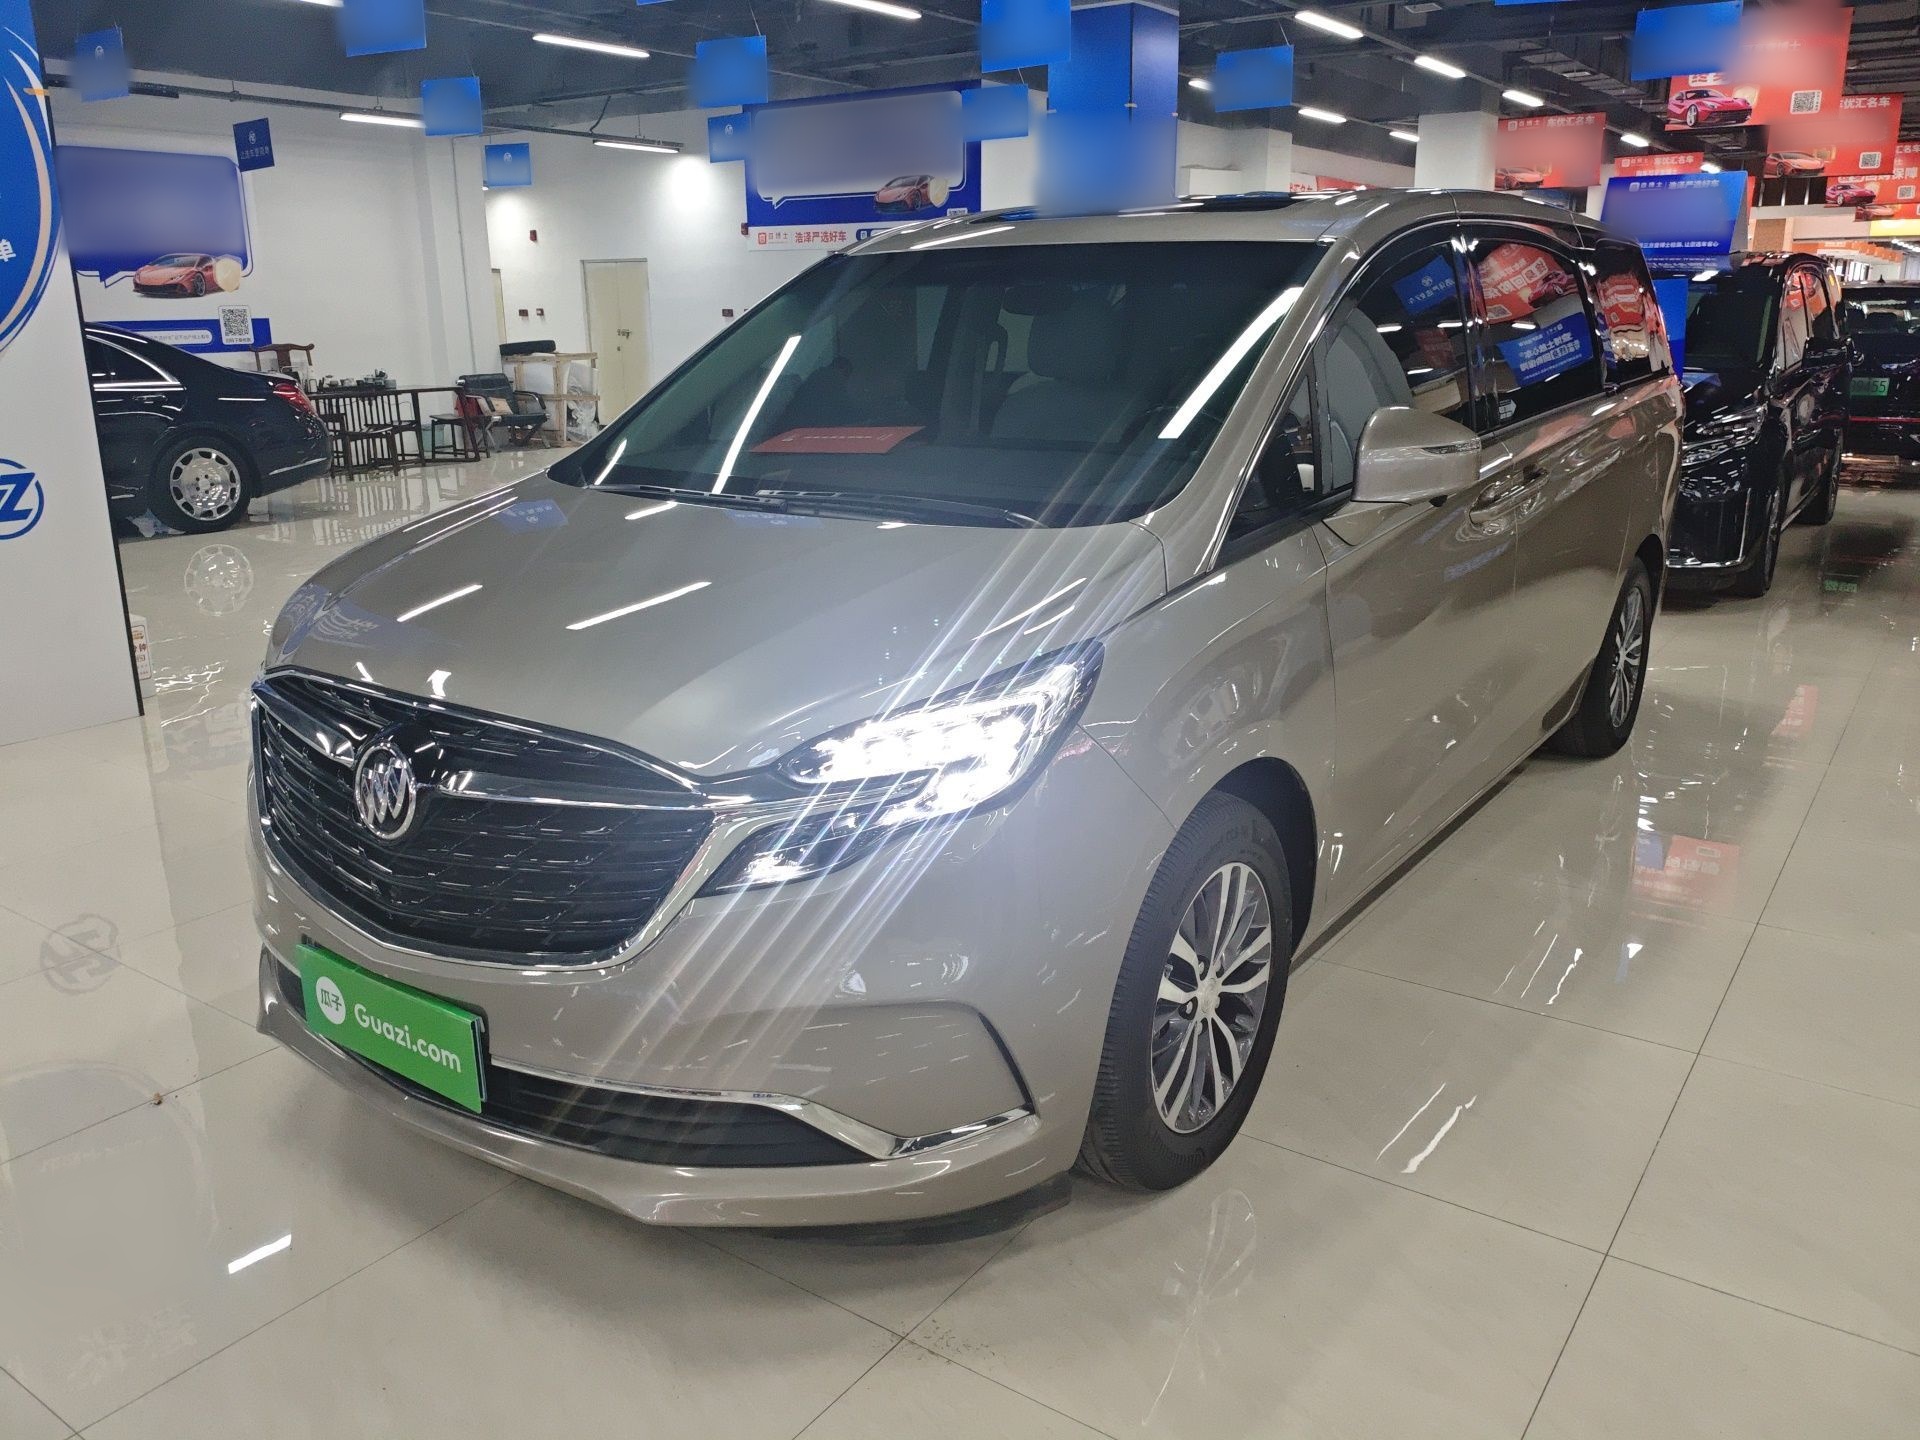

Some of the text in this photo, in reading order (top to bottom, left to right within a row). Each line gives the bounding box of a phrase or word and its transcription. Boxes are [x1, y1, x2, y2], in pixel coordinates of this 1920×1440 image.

[795, 231, 847, 244] 浩泽严选好车
[320, 988, 342, 1012] 瓜子
[354, 1003, 462, 1073] Guazi.com
